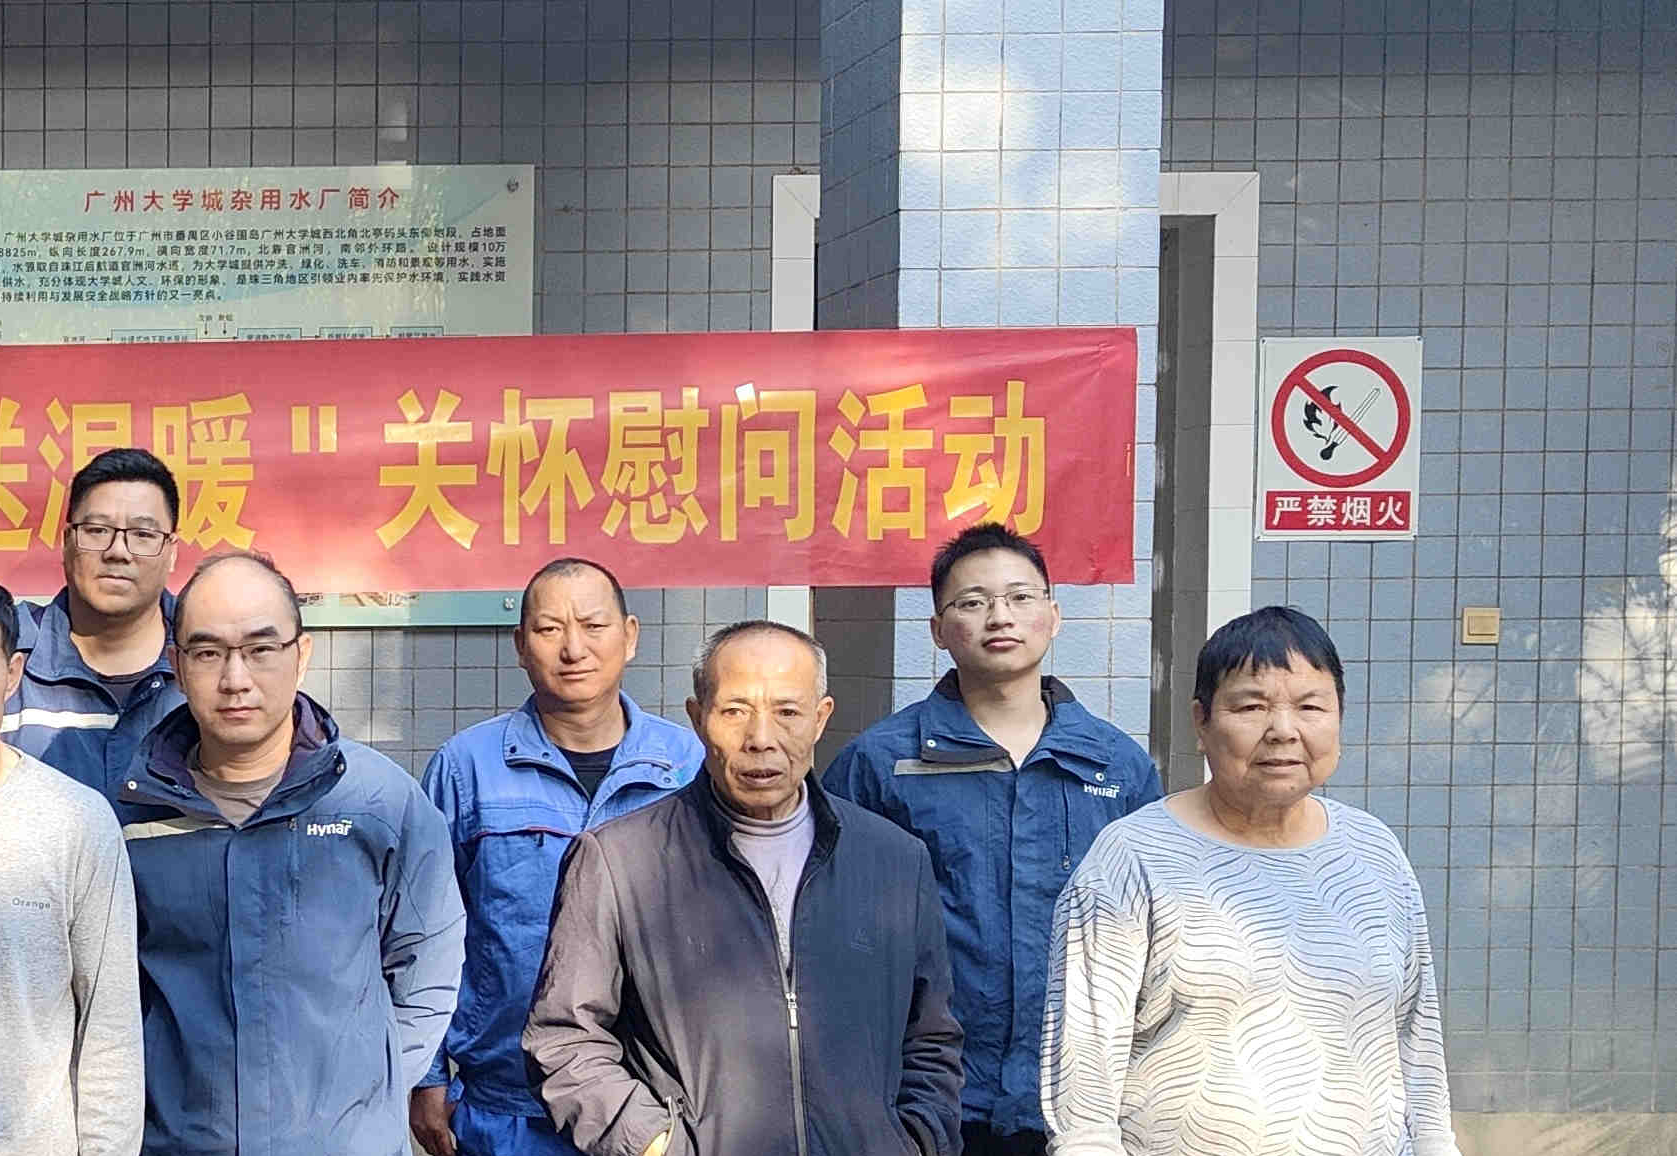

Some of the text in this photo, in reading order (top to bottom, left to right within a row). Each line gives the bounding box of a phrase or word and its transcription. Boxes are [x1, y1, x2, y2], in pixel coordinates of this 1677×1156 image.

[85, 187, 399, 213] 广州大学城杂用水厂简介
[1272, 495, 1406, 527] 严禁烟火
